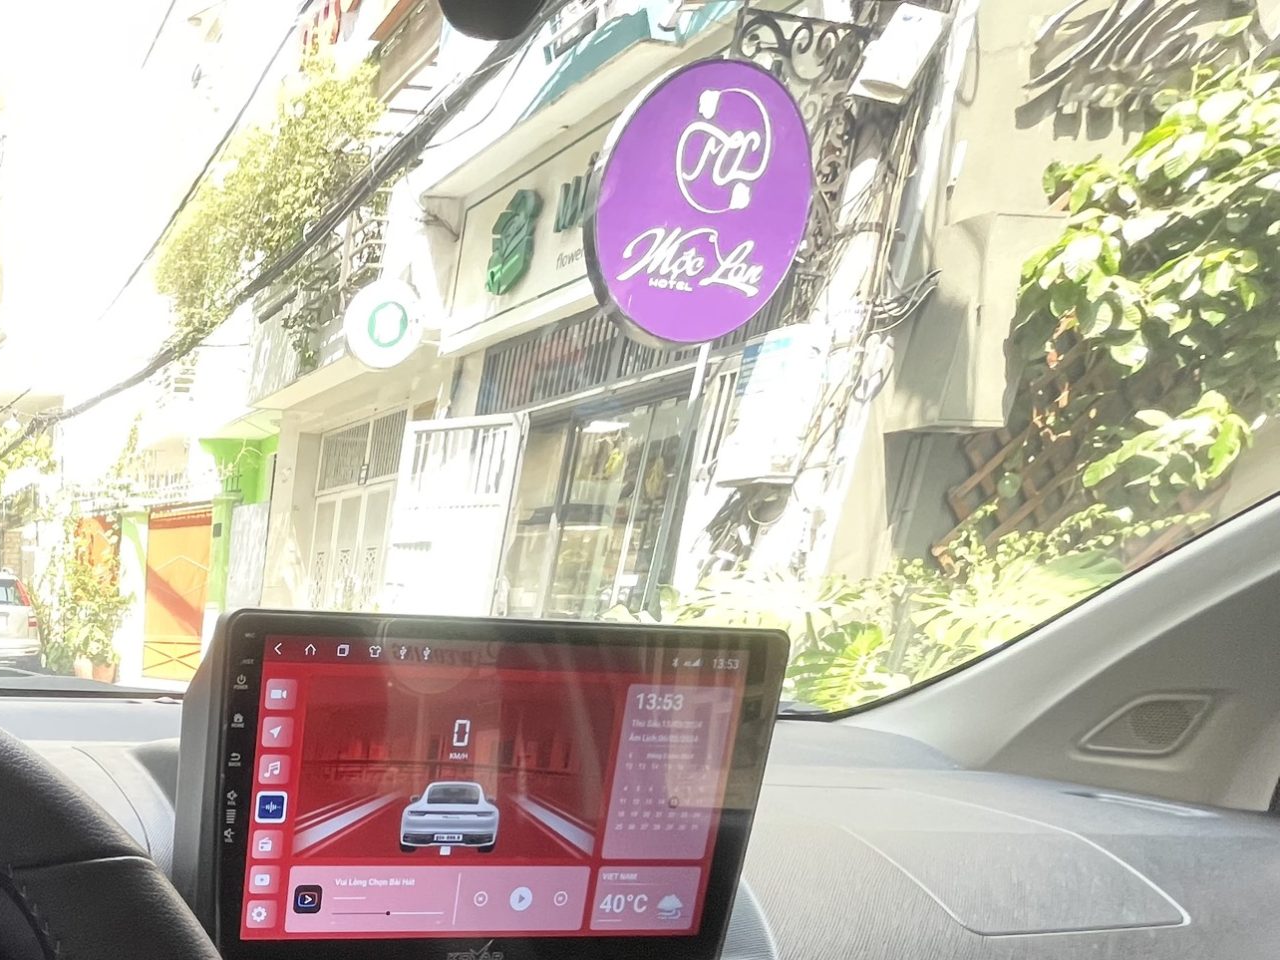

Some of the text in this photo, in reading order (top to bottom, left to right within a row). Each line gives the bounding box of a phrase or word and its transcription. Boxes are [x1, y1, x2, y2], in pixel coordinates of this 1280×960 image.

[699, 240, 764, 297] Lan
[648, 277, 694, 292] HOTEL
[712, 658, 740, 670] 13:53
[635, 692, 684, 711] 13:53
[452, 719, 471, 747] 0
[599, 894, 649, 913] 40°C
